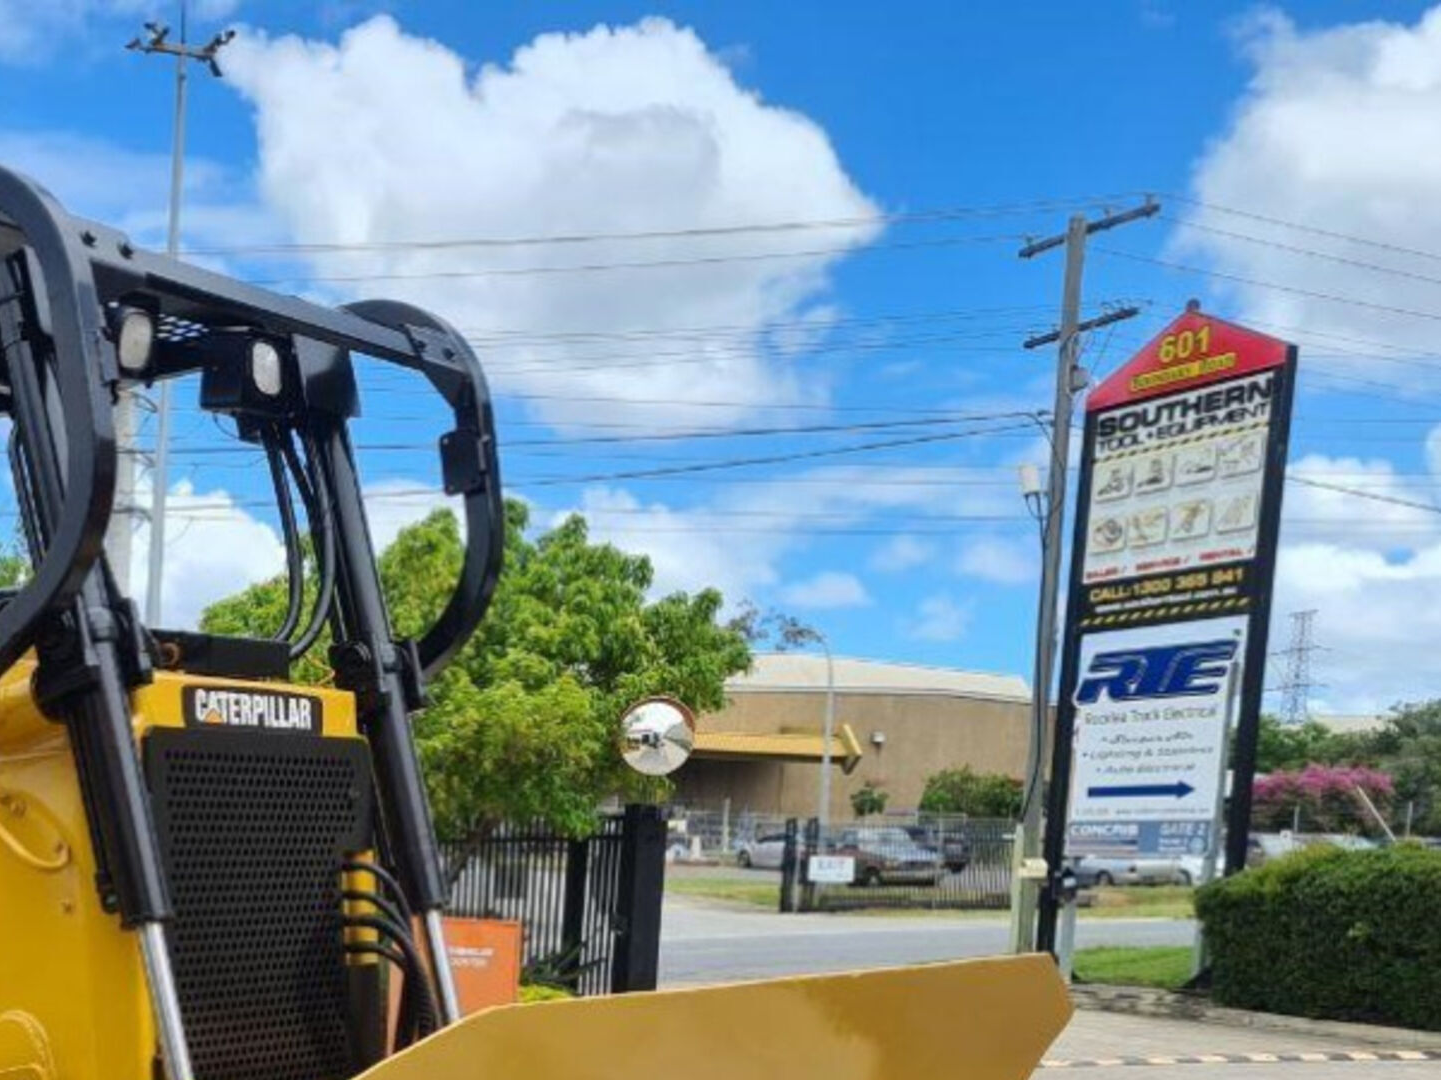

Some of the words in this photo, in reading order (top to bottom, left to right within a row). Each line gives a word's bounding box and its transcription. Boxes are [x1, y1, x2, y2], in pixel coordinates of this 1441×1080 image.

[1159, 326, 1211, 363] 601
[1097, 435, 1144, 452] TOOL
[1155, 402, 1271, 440] EQUIPMENT
[1098, 377, 1275, 437] SOUTHERN
[1076, 639, 1240, 706] RTE
[194, 688, 312, 730] CATERPILLAR
